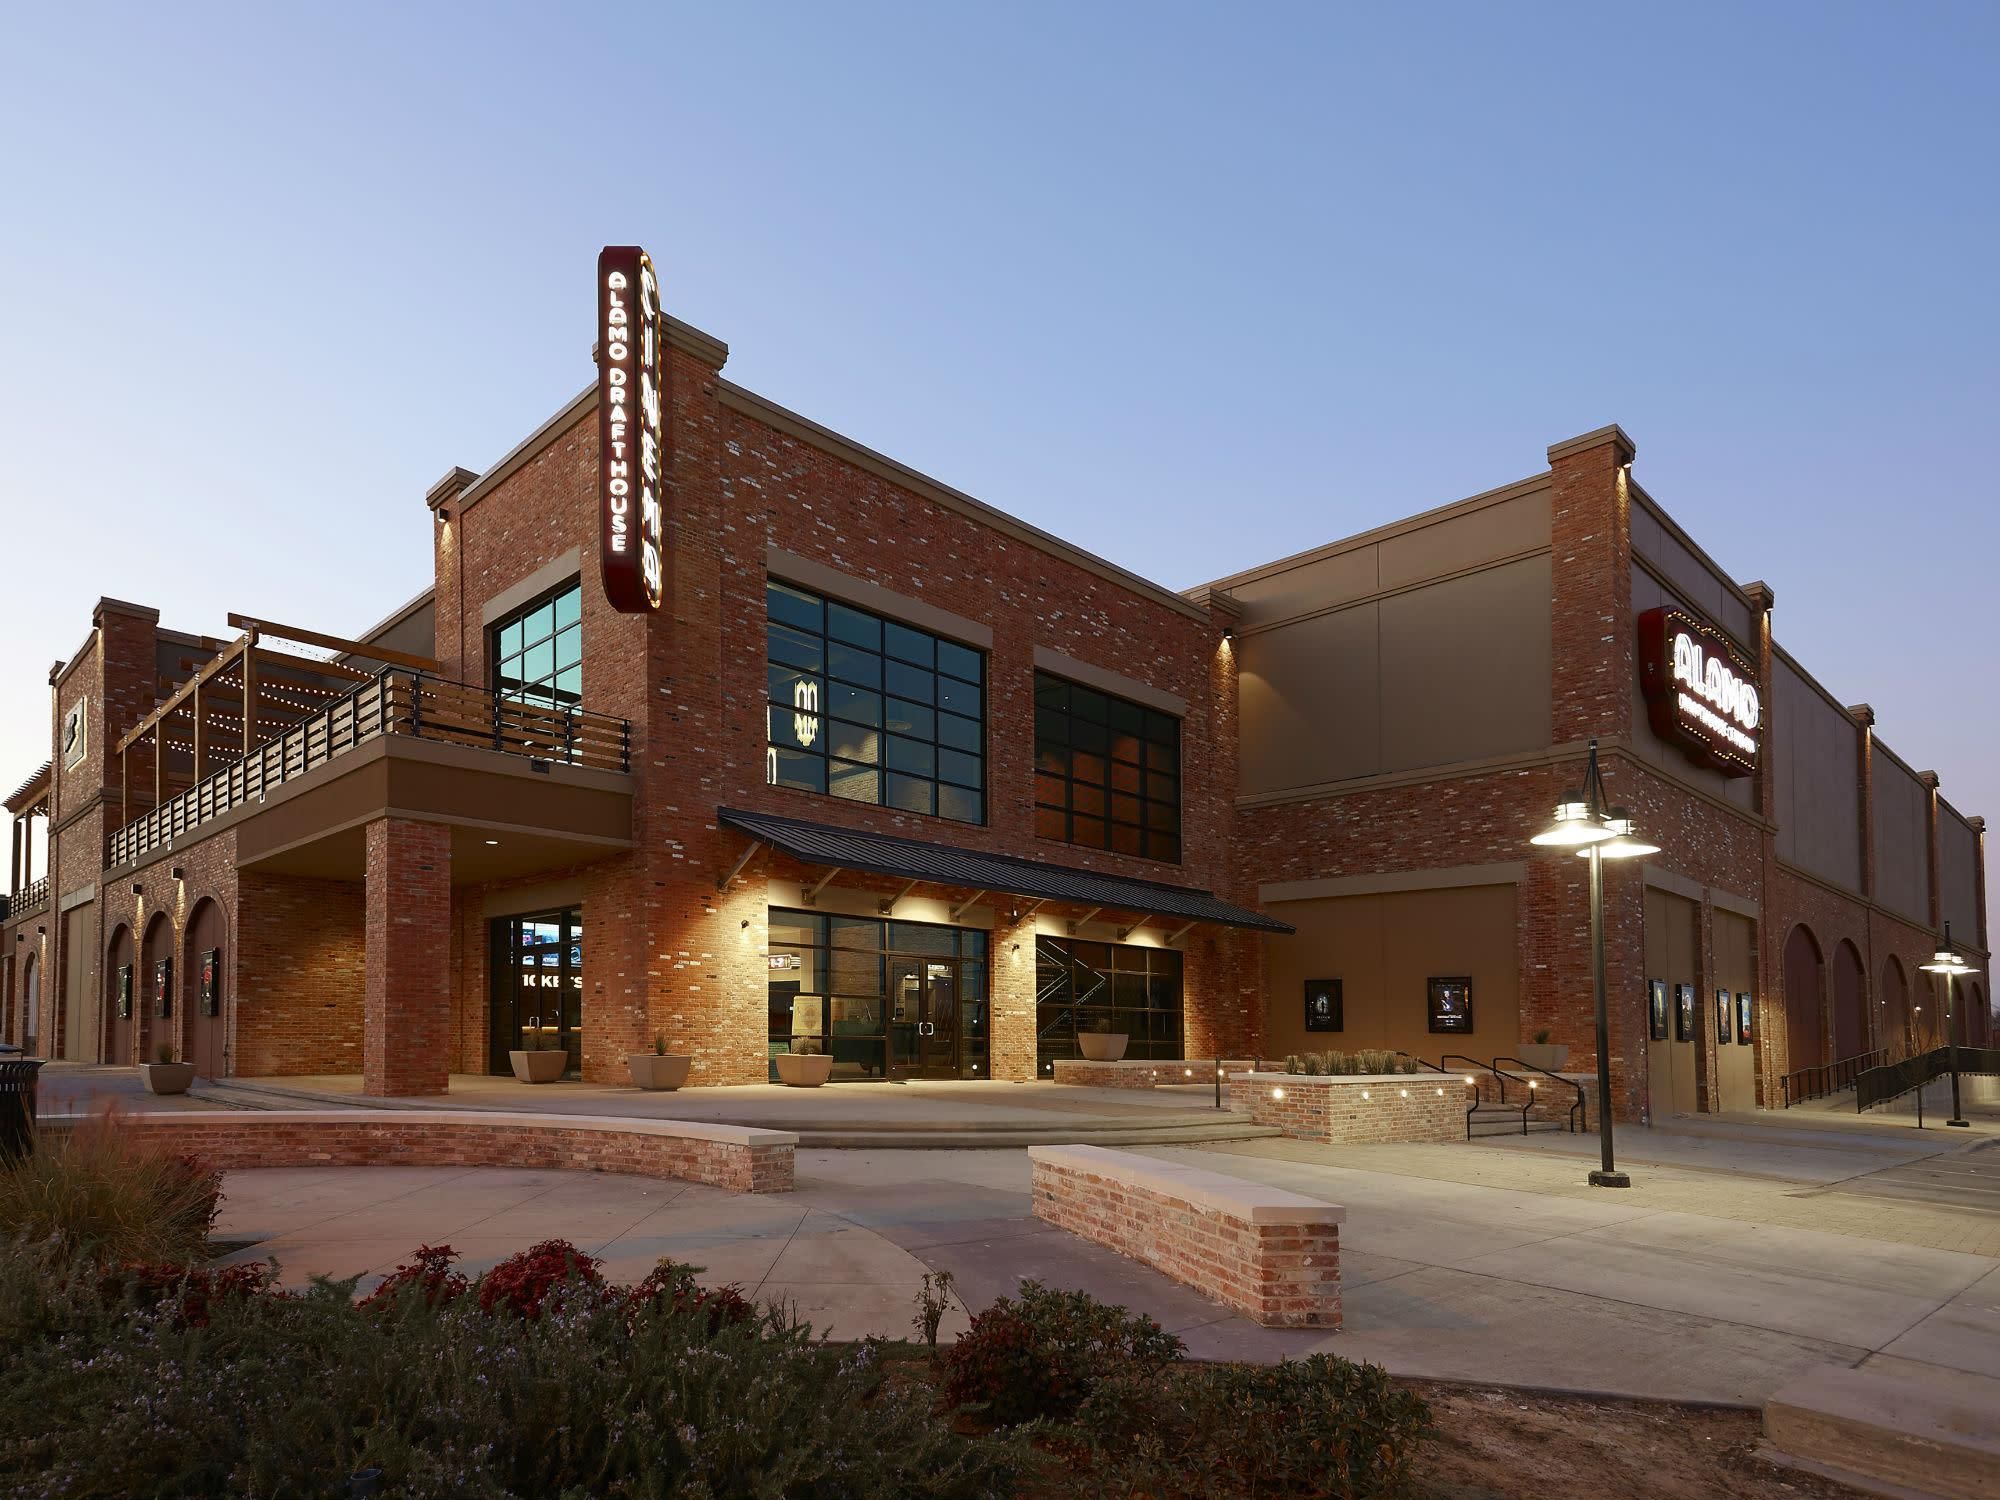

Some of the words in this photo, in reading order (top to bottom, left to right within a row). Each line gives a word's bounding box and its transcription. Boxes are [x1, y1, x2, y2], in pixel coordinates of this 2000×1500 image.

[608, 271, 628, 361] ALAMO
[609, 367, 629, 552] DRAFTHOUSE
[641, 265, 659, 590] CINEMA
[1674, 633, 1759, 729] ALAMO
[522, 974, 583, 989] ICKES
